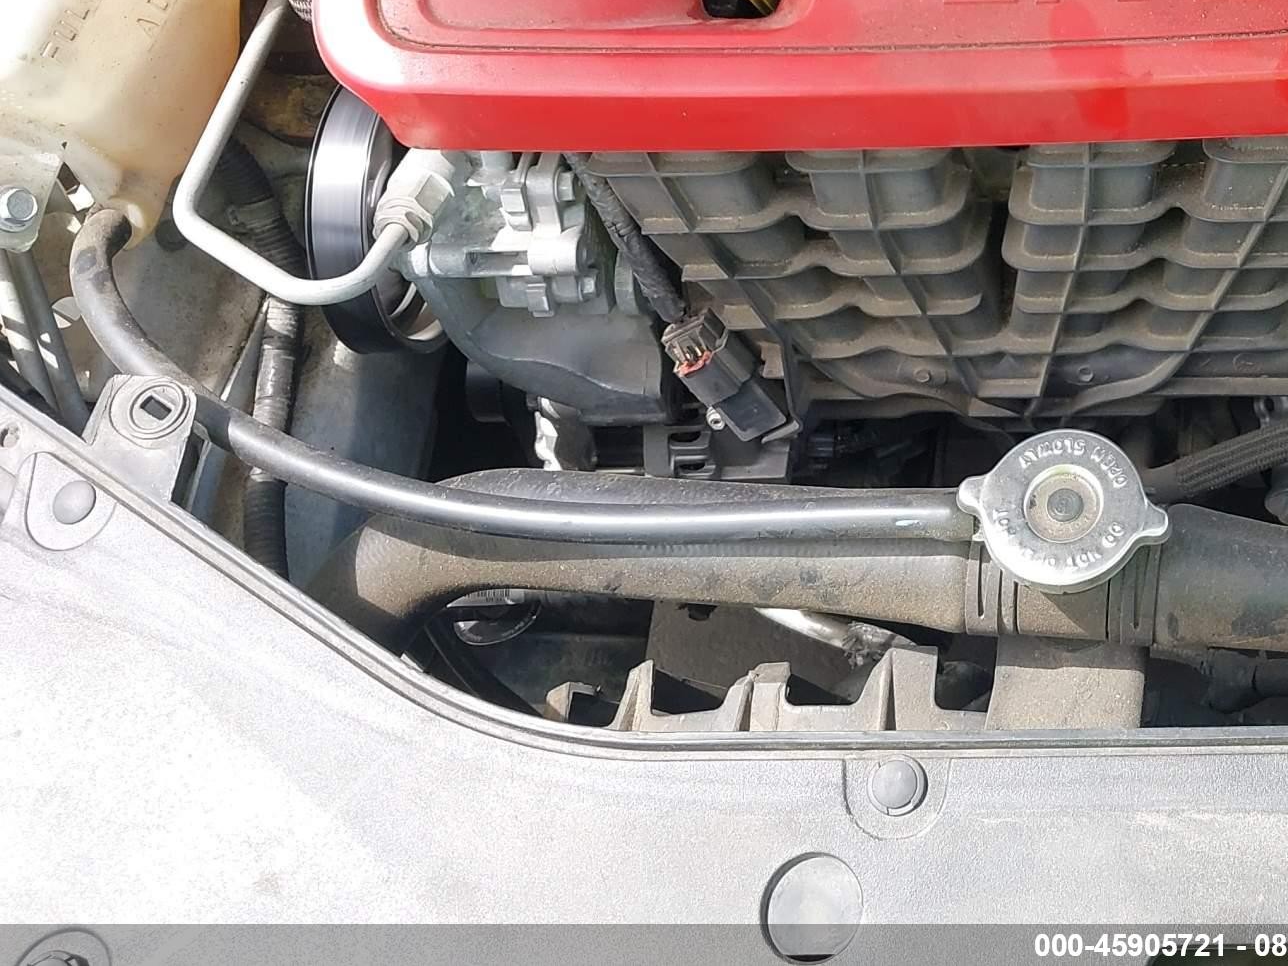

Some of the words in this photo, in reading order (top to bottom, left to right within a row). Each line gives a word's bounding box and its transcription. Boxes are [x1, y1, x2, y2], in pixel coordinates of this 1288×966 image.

[1018, 437, 1087, 470] SLOWLY
[1090, 445, 1129, 489] OPEN
[1101, 521, 1126, 549] DO
